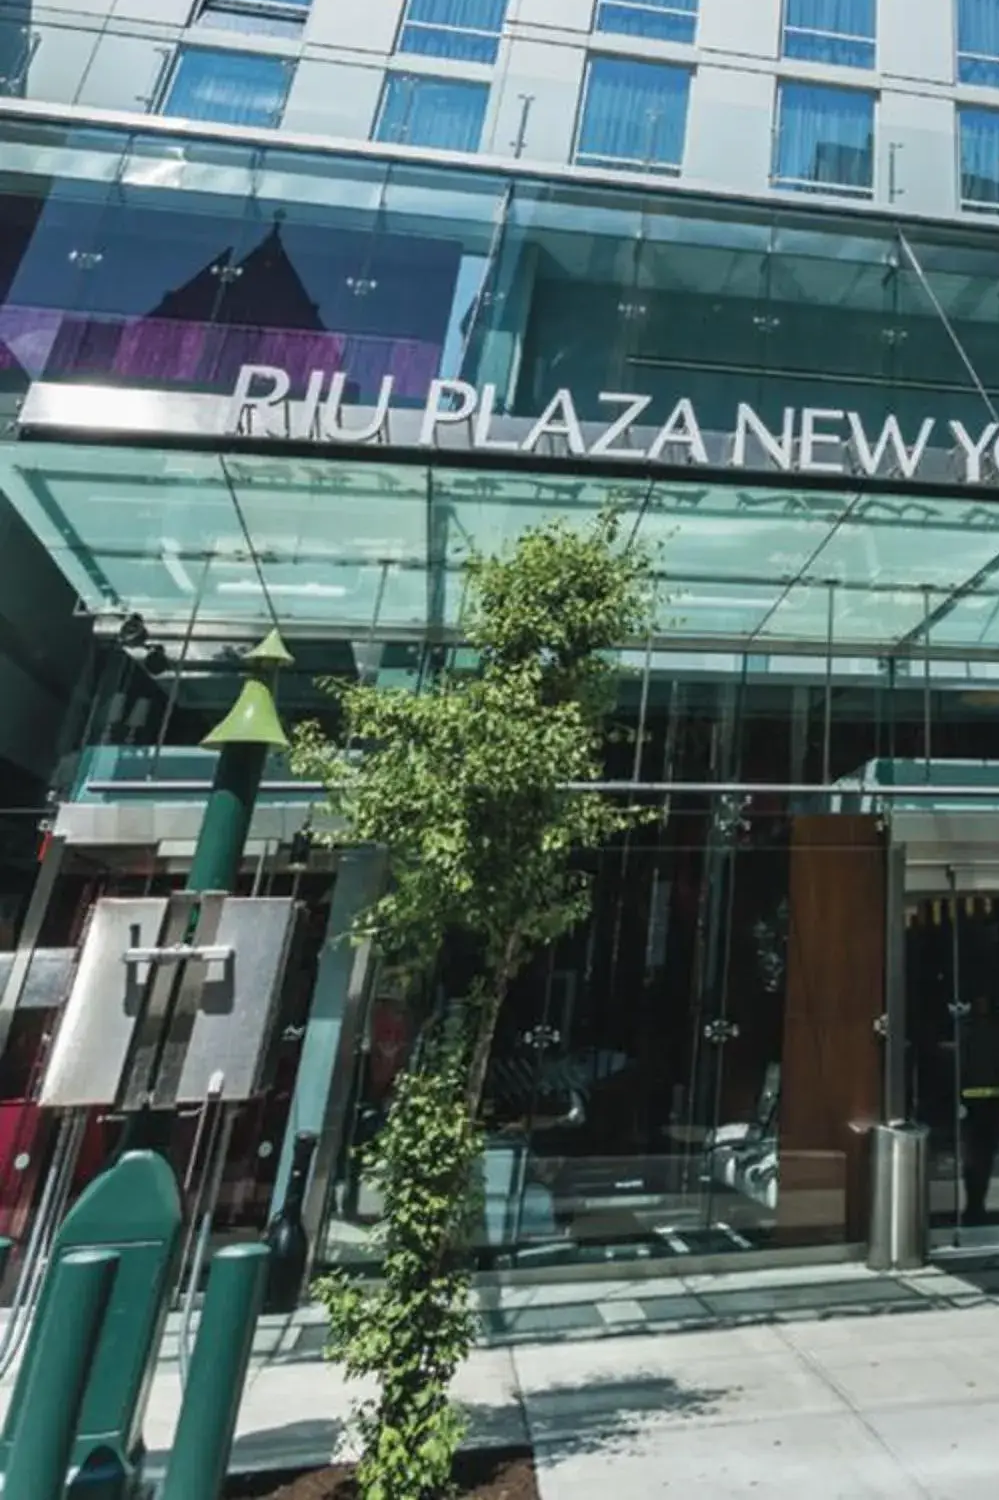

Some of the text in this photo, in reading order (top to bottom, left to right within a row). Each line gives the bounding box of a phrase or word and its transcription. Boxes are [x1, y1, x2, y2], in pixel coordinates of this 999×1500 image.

[233, 365, 394, 441] RIU
[418, 380, 708, 463] PLAZA
[732, 403, 936, 477] NEW
